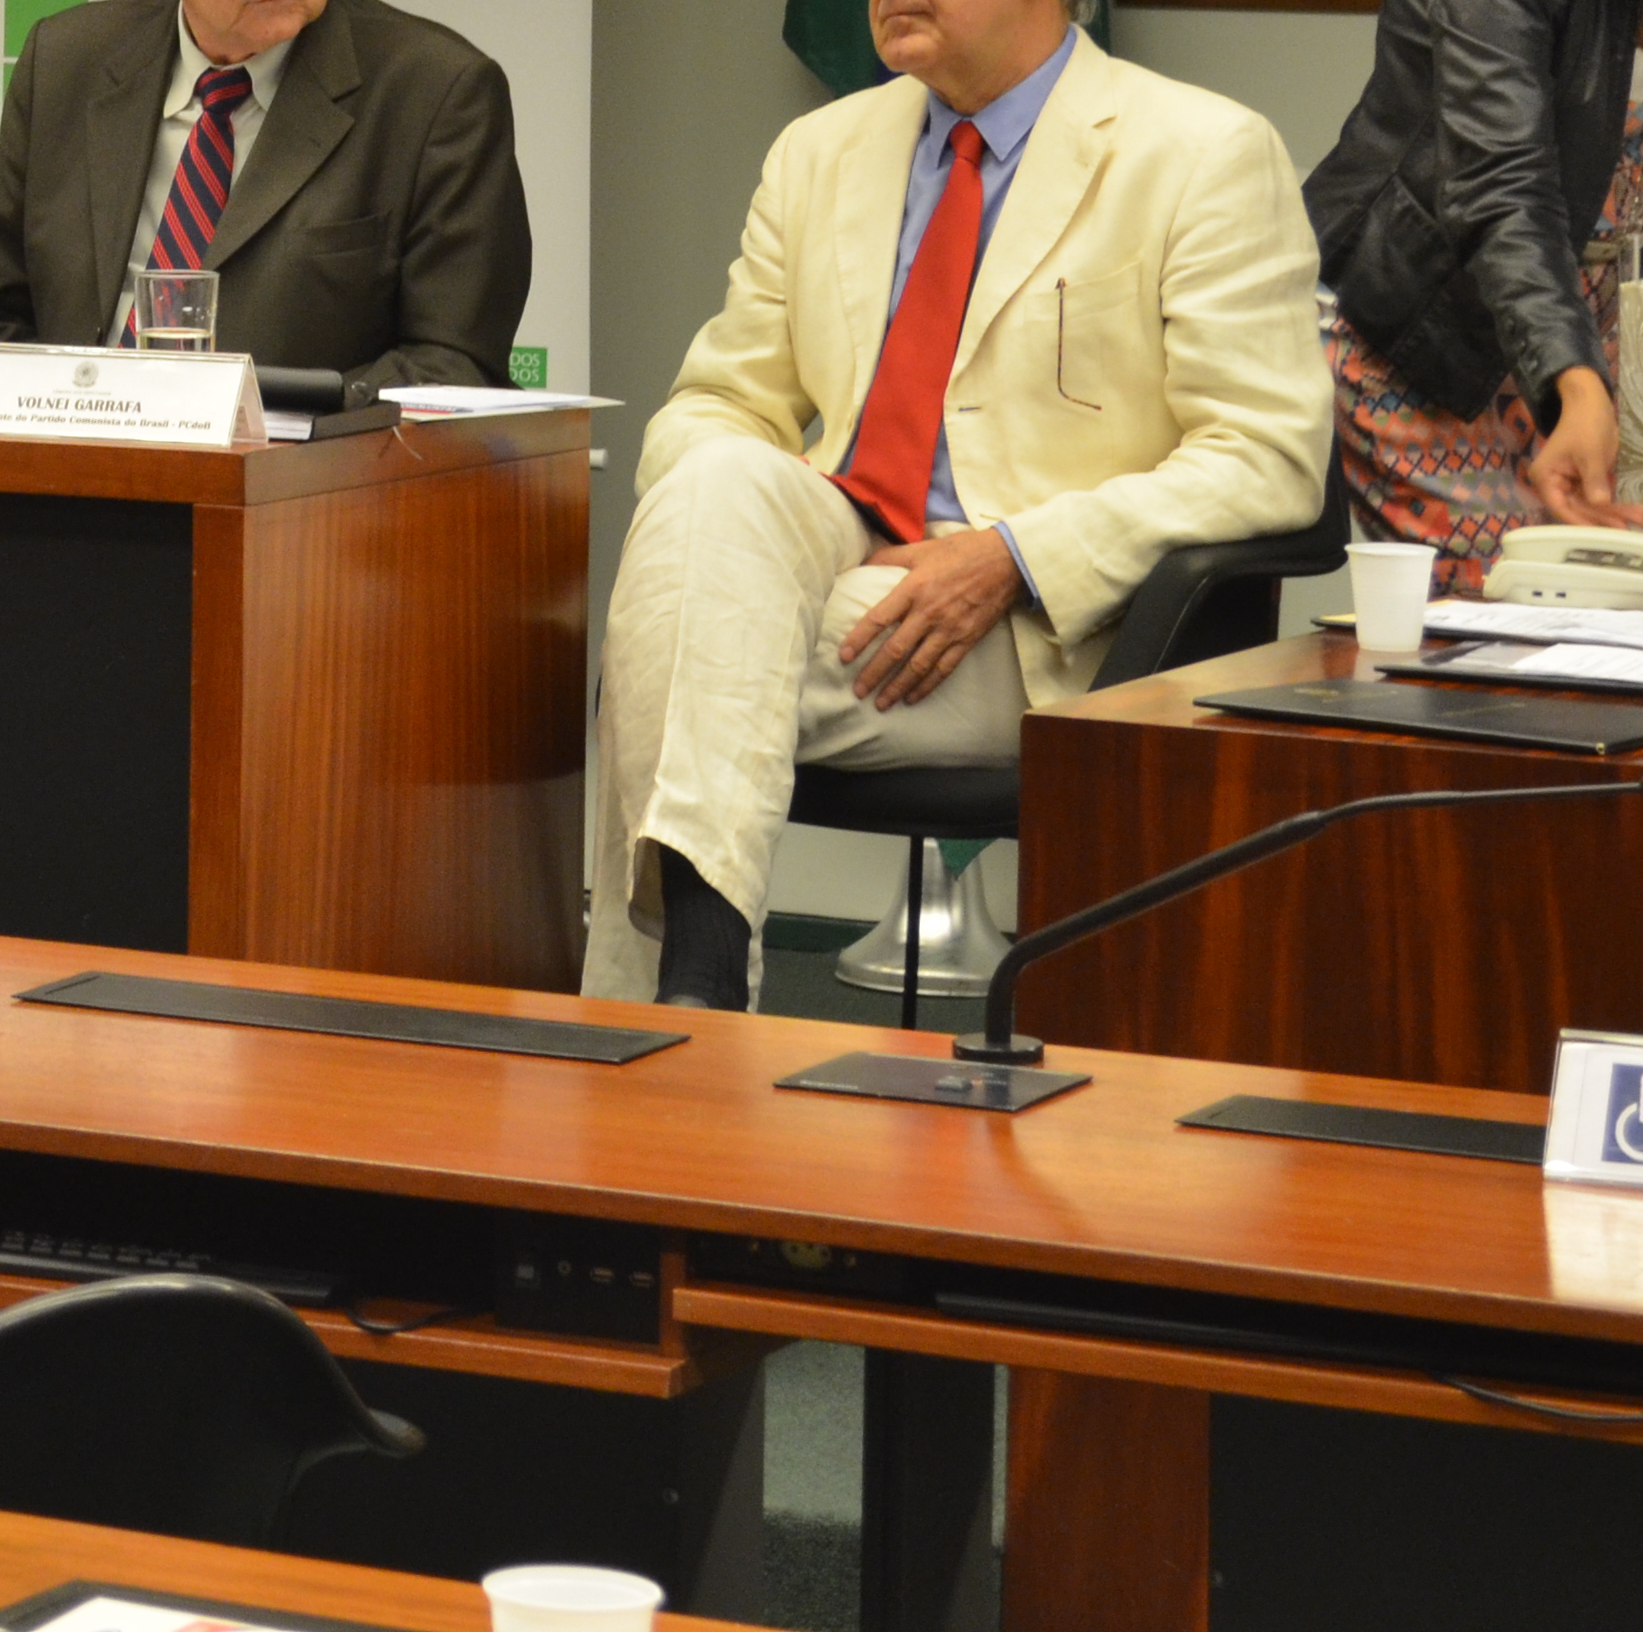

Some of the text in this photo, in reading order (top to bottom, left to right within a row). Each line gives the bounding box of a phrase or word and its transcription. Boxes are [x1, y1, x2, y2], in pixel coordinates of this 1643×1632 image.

[17, 396, 143, 414] VOLNEI GARRAFA
[15, 413, 27, 423] do
[30, 413, 66, 424] Partido
[69, 415, 121, 427] Comunista
[124, 417, 137, 427] do
[139, 418, 169, 429] Brasil
[178, 420, 211, 431] PCdoB
